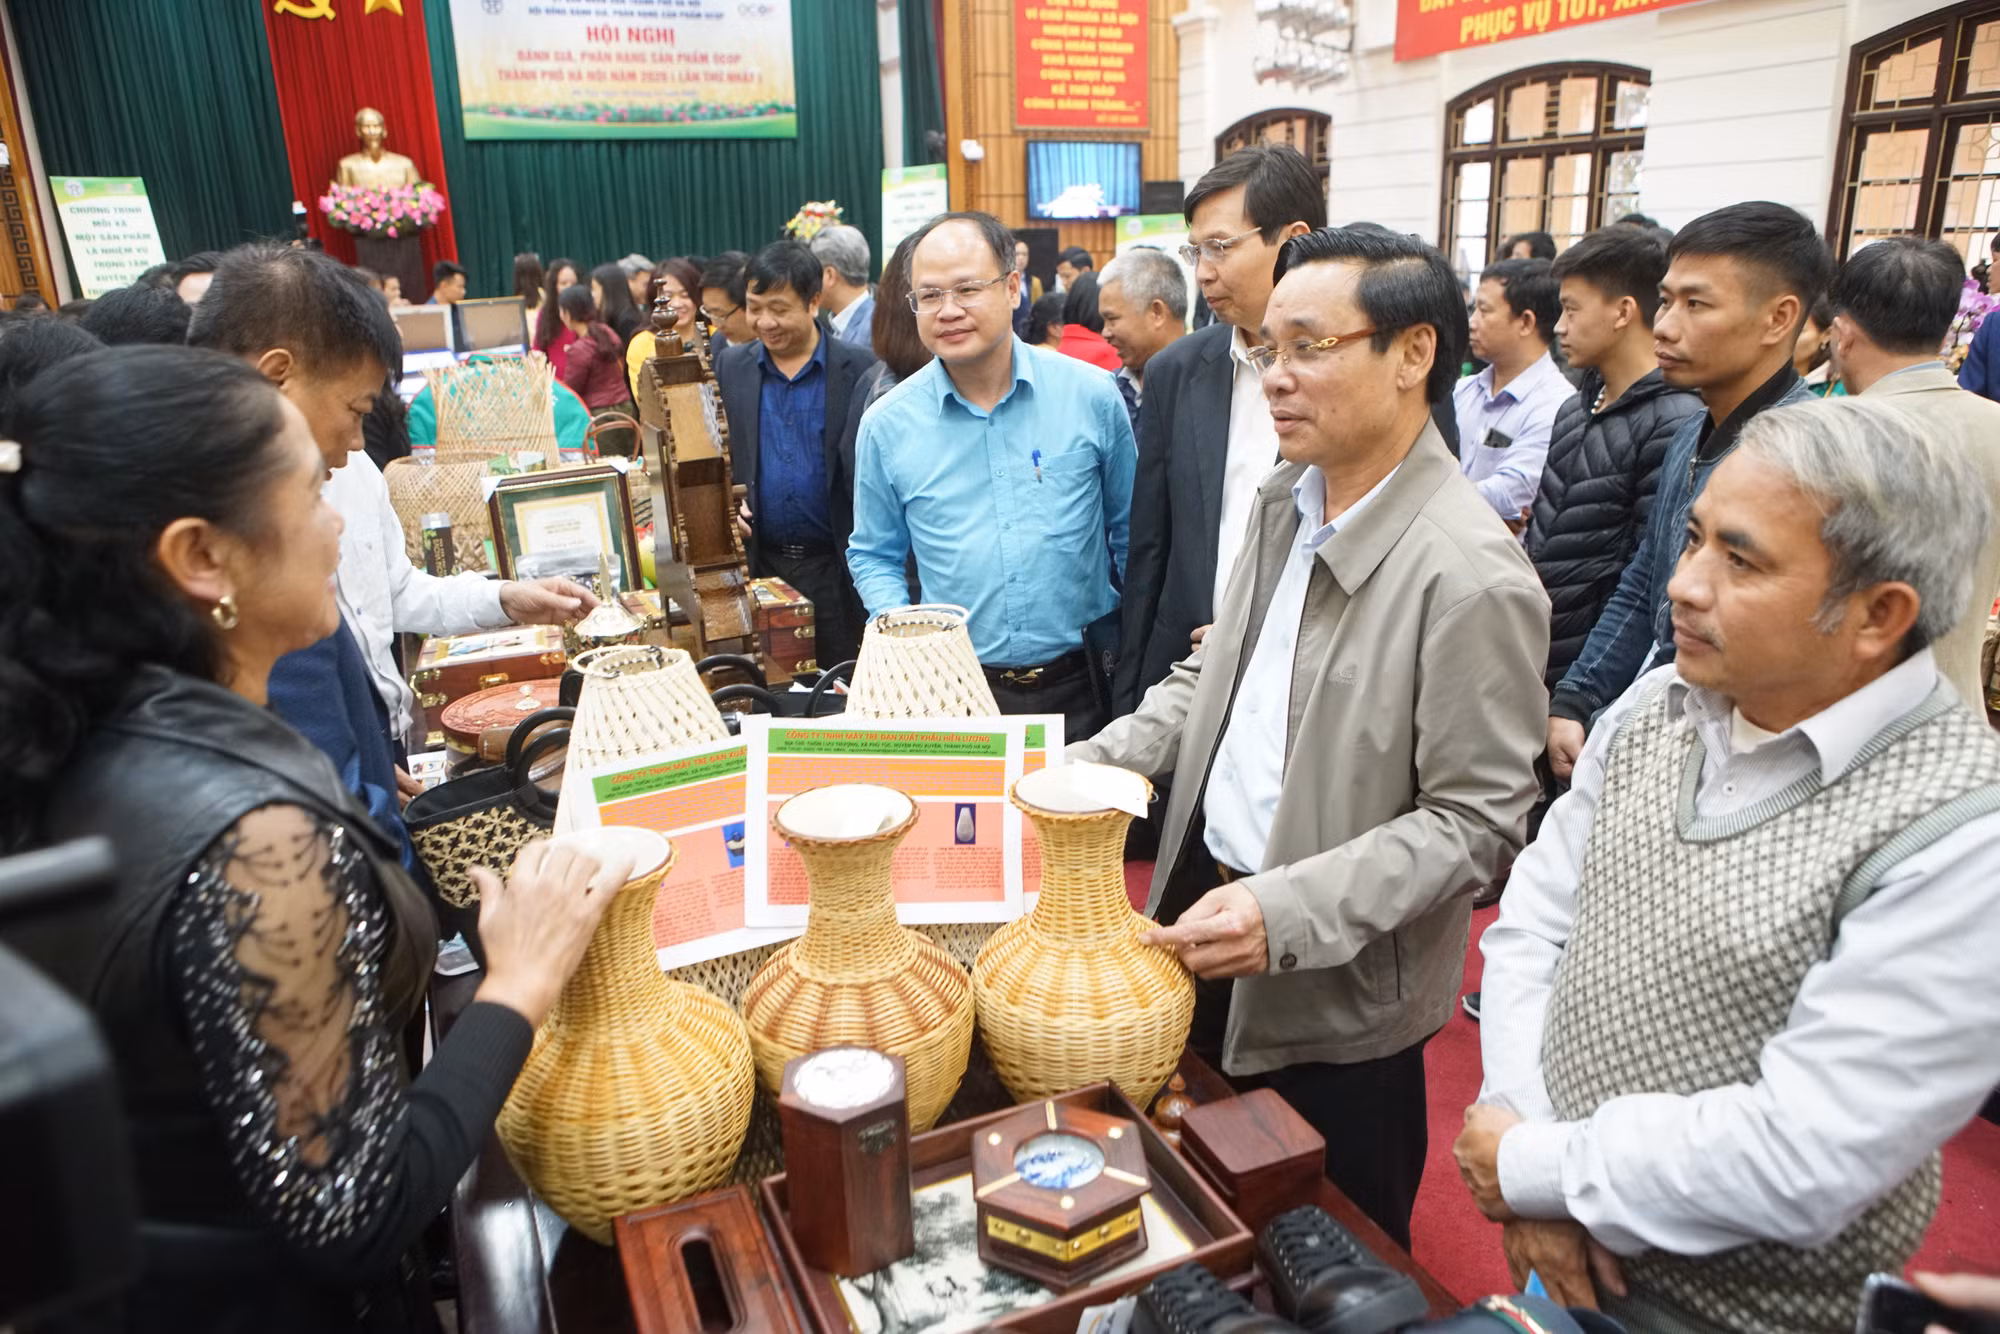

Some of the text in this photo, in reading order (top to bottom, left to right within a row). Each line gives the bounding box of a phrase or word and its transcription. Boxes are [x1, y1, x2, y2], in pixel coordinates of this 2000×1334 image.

[587, 22, 675, 48] HỘI NGHỊ
[1460, 5, 1517, 44] PHỤC
[1522, 0, 1552, 32] VỤ
[69, 205, 111, 215] CHƯƠNG
[785, 729, 809, 739] CÔNG
[811, 731, 821, 739] TY
[823, 731, 844, 740] TNHH
[962, 734, 991, 743] LƯƠNG
[611, 773, 635, 785] CÔNG
[637, 769, 647, 778] TY
[729, 746, 747, 759] XUẤ
